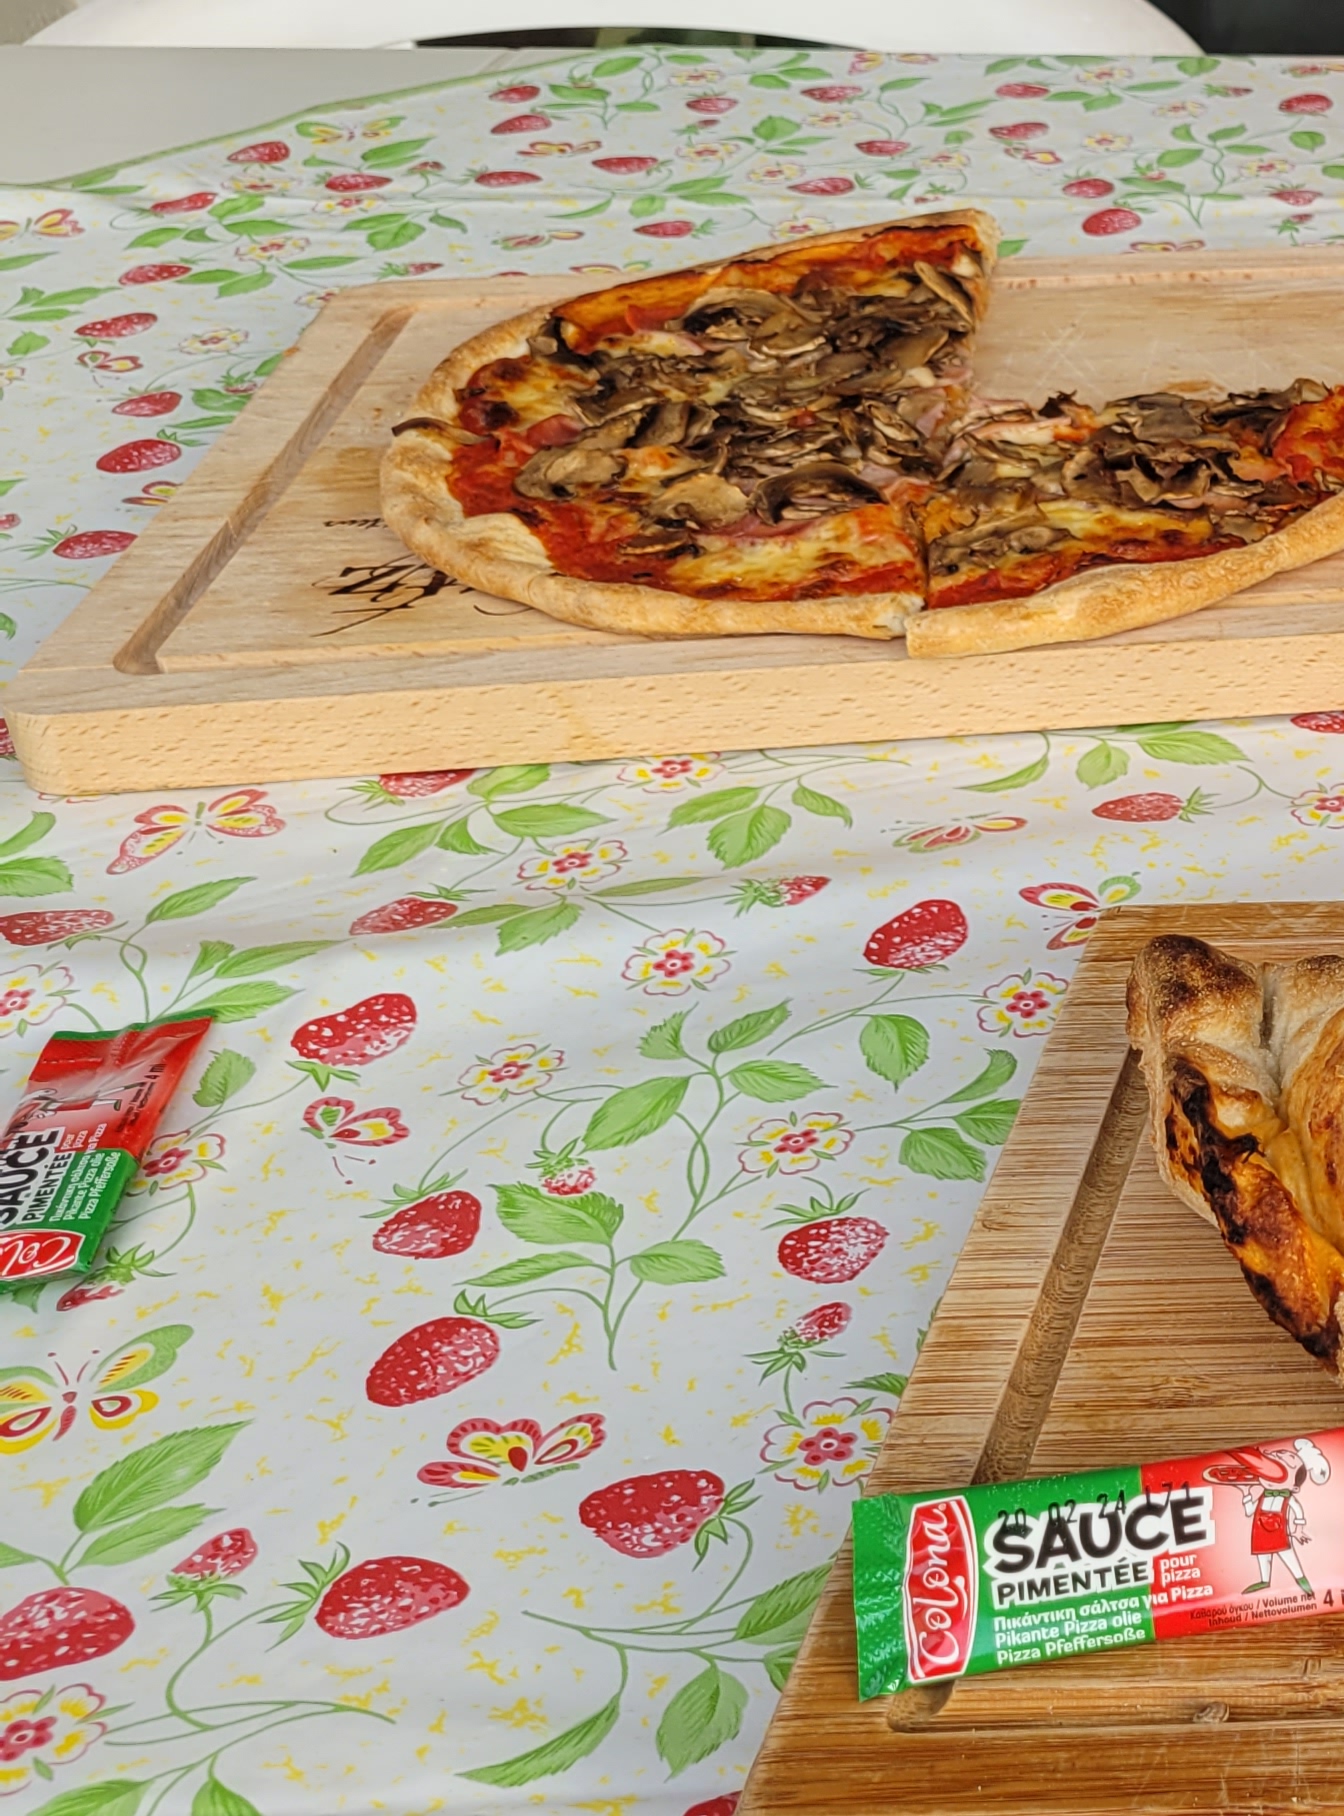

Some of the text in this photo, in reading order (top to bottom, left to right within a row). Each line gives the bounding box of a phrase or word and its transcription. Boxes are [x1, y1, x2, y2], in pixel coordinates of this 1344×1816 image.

[22, 1152, 72, 1221] PIMENTÉE
[992, 1496, 1207, 1573] SAUCE
[997, 1557, 1149, 1605] PIMENTÉE
[1160, 1554, 1197, 1573] pour
[1161, 1567, 1200, 1587] pizza
[913, 1506, 967, 1665] Colona
[1262, 1595, 1298, 1608] Volume
[1323, 1589, 1334, 1607] 4
[994, 1583, 1213, 1632] Πικάντικη σάλτσα για Pizza
[1208, 1614, 1242, 1627] Inhoud
[1251, 1602, 1317, 1620] Nettovolumen
[995, 1611, 1142, 1648] Pikante Pizza olie
[997, 1628, 1146, 1665] Pizza Pfeffersoße
